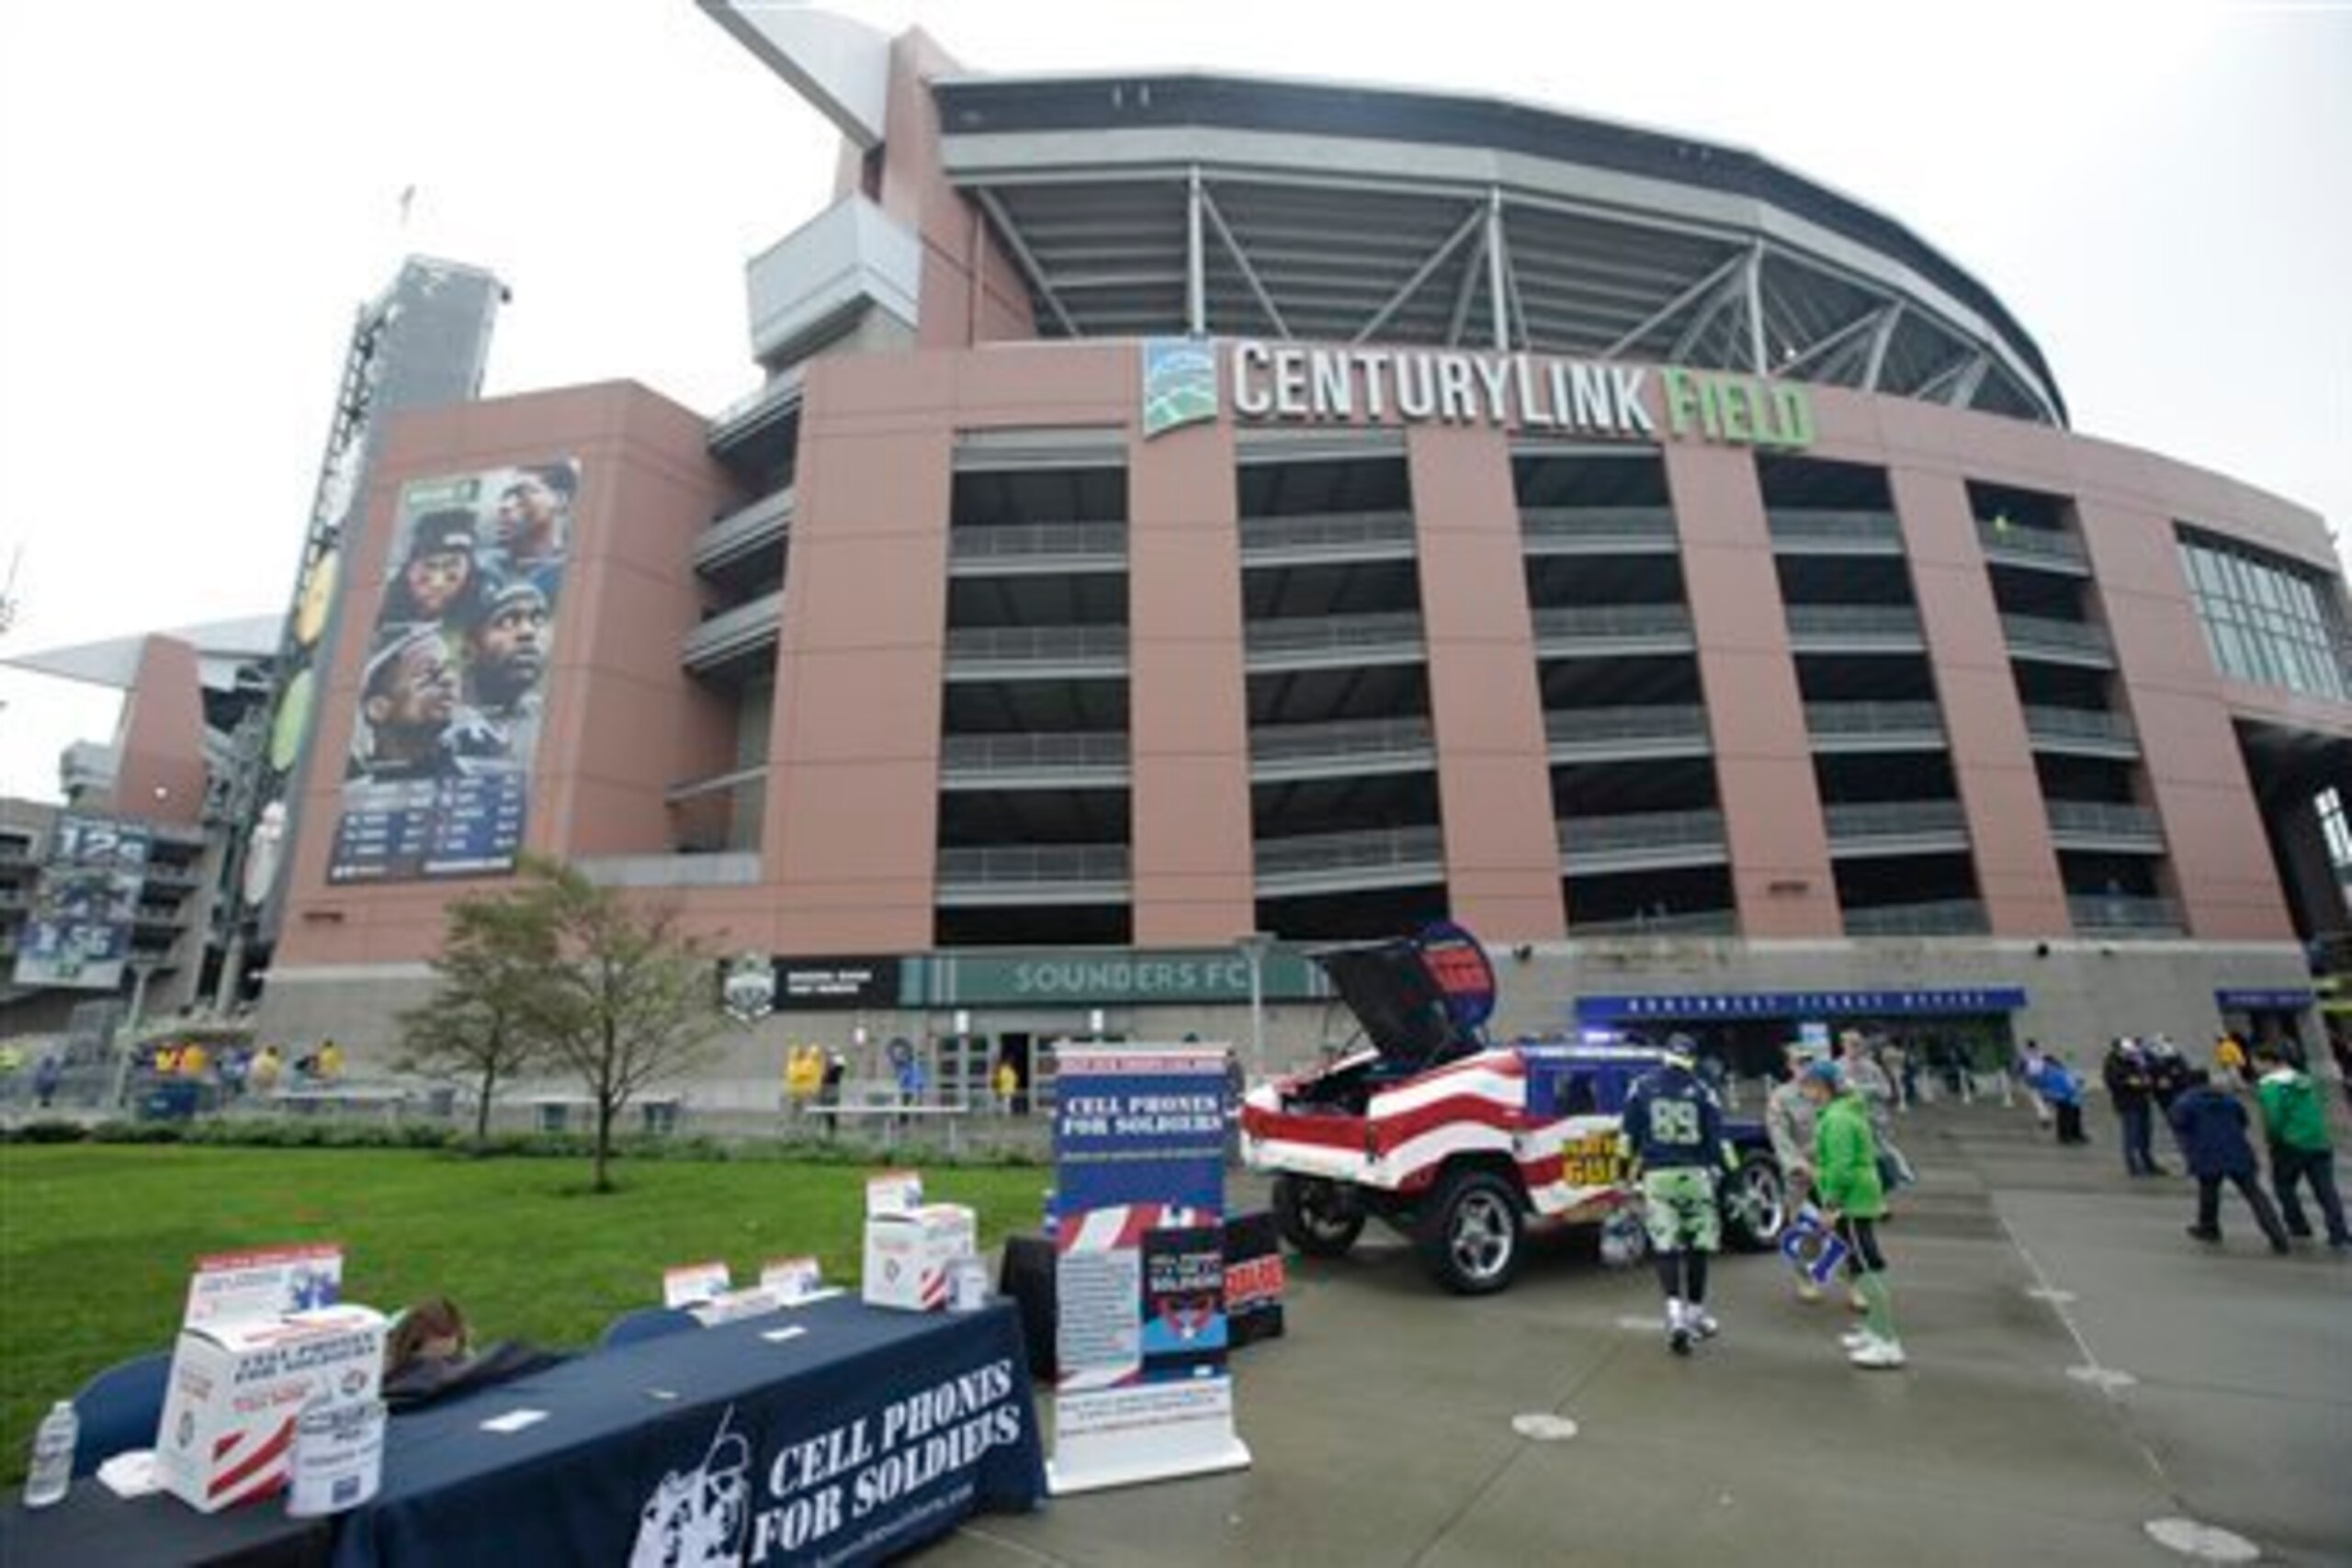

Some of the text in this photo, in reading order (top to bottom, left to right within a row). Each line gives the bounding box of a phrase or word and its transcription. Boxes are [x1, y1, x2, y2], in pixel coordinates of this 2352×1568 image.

[1231, 340, 1816, 448] CENTURYLINK FIELD
[1014, 961, 1248, 993] SOUNDERS FC
[749, 1491, 843, 1565] FOR
[852, 1404, 1022, 1518] SOLDIERS
[768, 1419, 873, 1499] CELL
[882, 1359, 1013, 1451] PHONES
